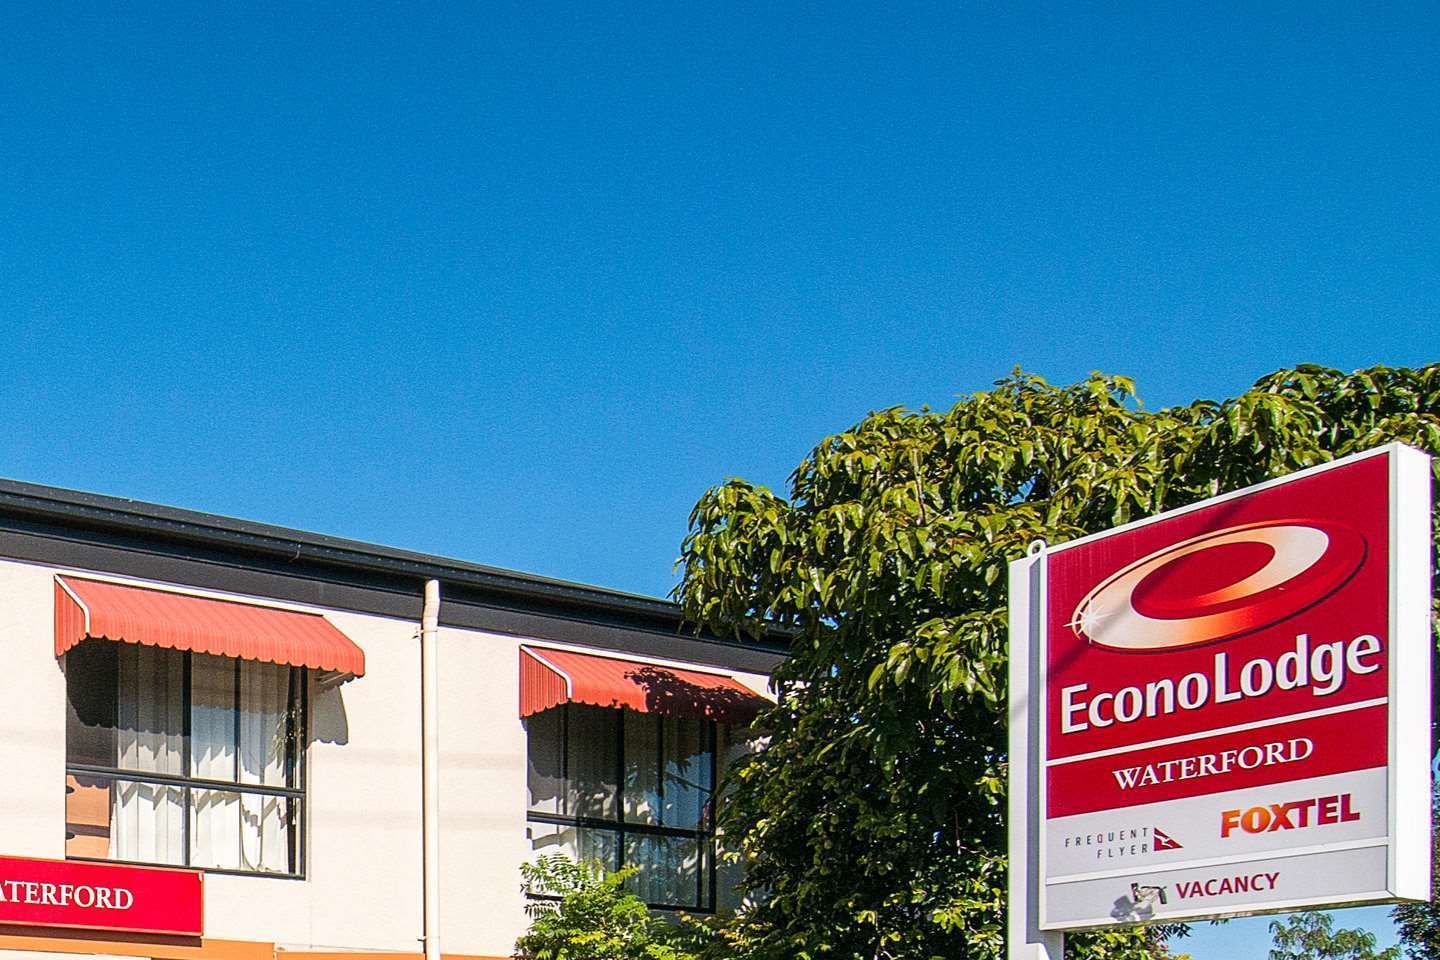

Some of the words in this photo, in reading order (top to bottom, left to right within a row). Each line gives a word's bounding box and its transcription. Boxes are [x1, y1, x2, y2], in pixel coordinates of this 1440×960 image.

[1112, 737, 1314, 790] WATERFORD
[1220, 793, 1360, 838] FOXTEL
[1065, 827, 1148, 848] FREQUENT
[1097, 843, 1148, 859] FLYER
[1176, 872, 1280, 900] VACANCY
